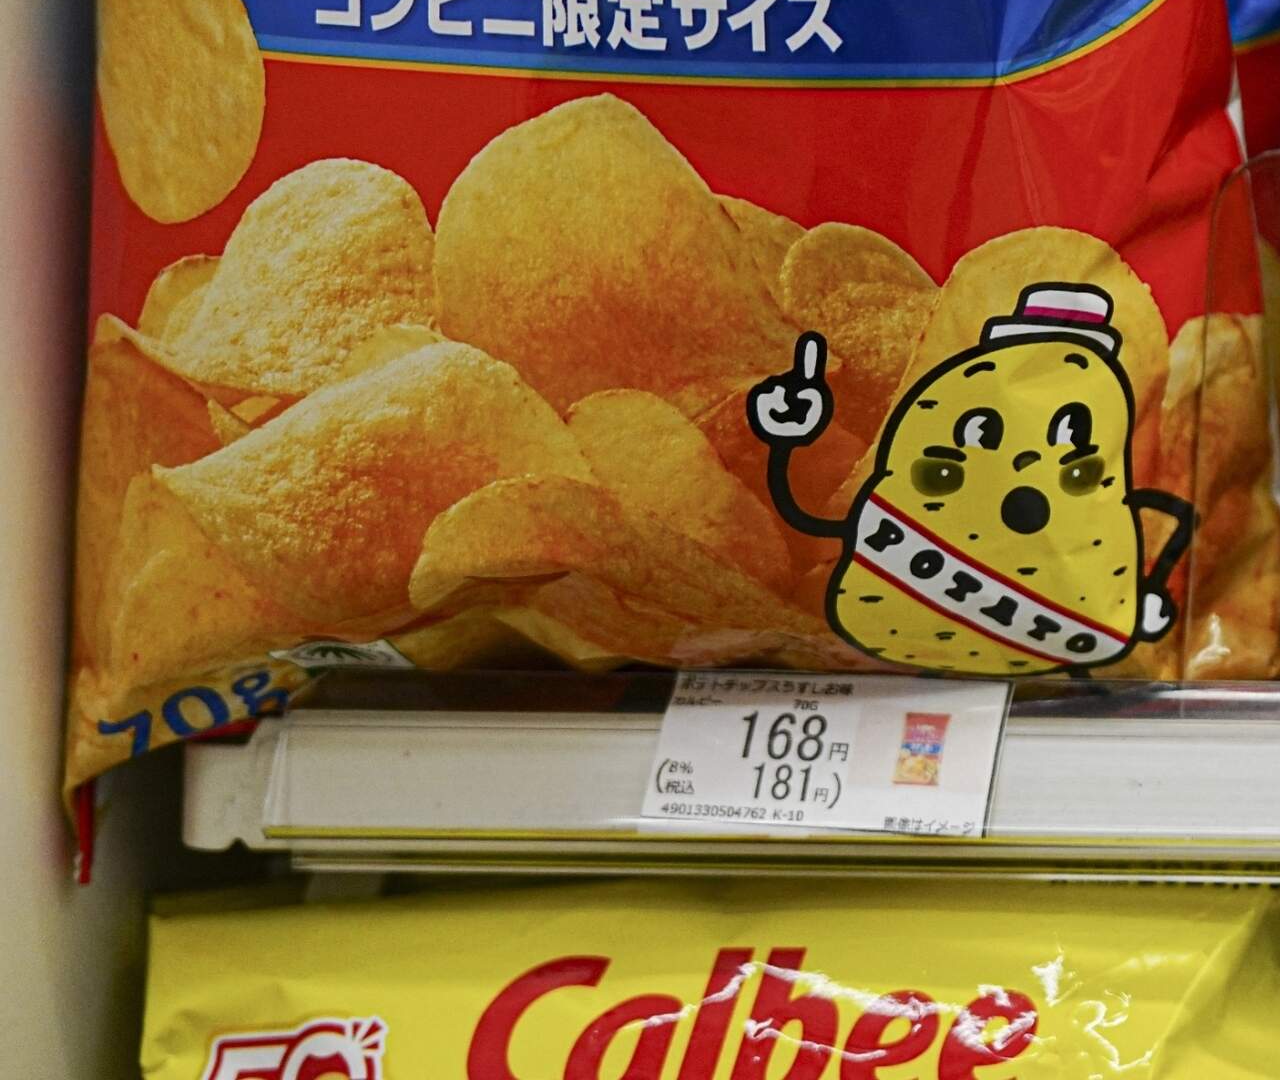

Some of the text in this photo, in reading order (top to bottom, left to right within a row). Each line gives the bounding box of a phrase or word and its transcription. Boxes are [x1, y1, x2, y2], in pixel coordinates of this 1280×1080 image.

[864, 517, 1098, 654] POTATO
[661, 803, 768, 821] 4901330504762
[466, 946, 1040, 1080] Calbee
